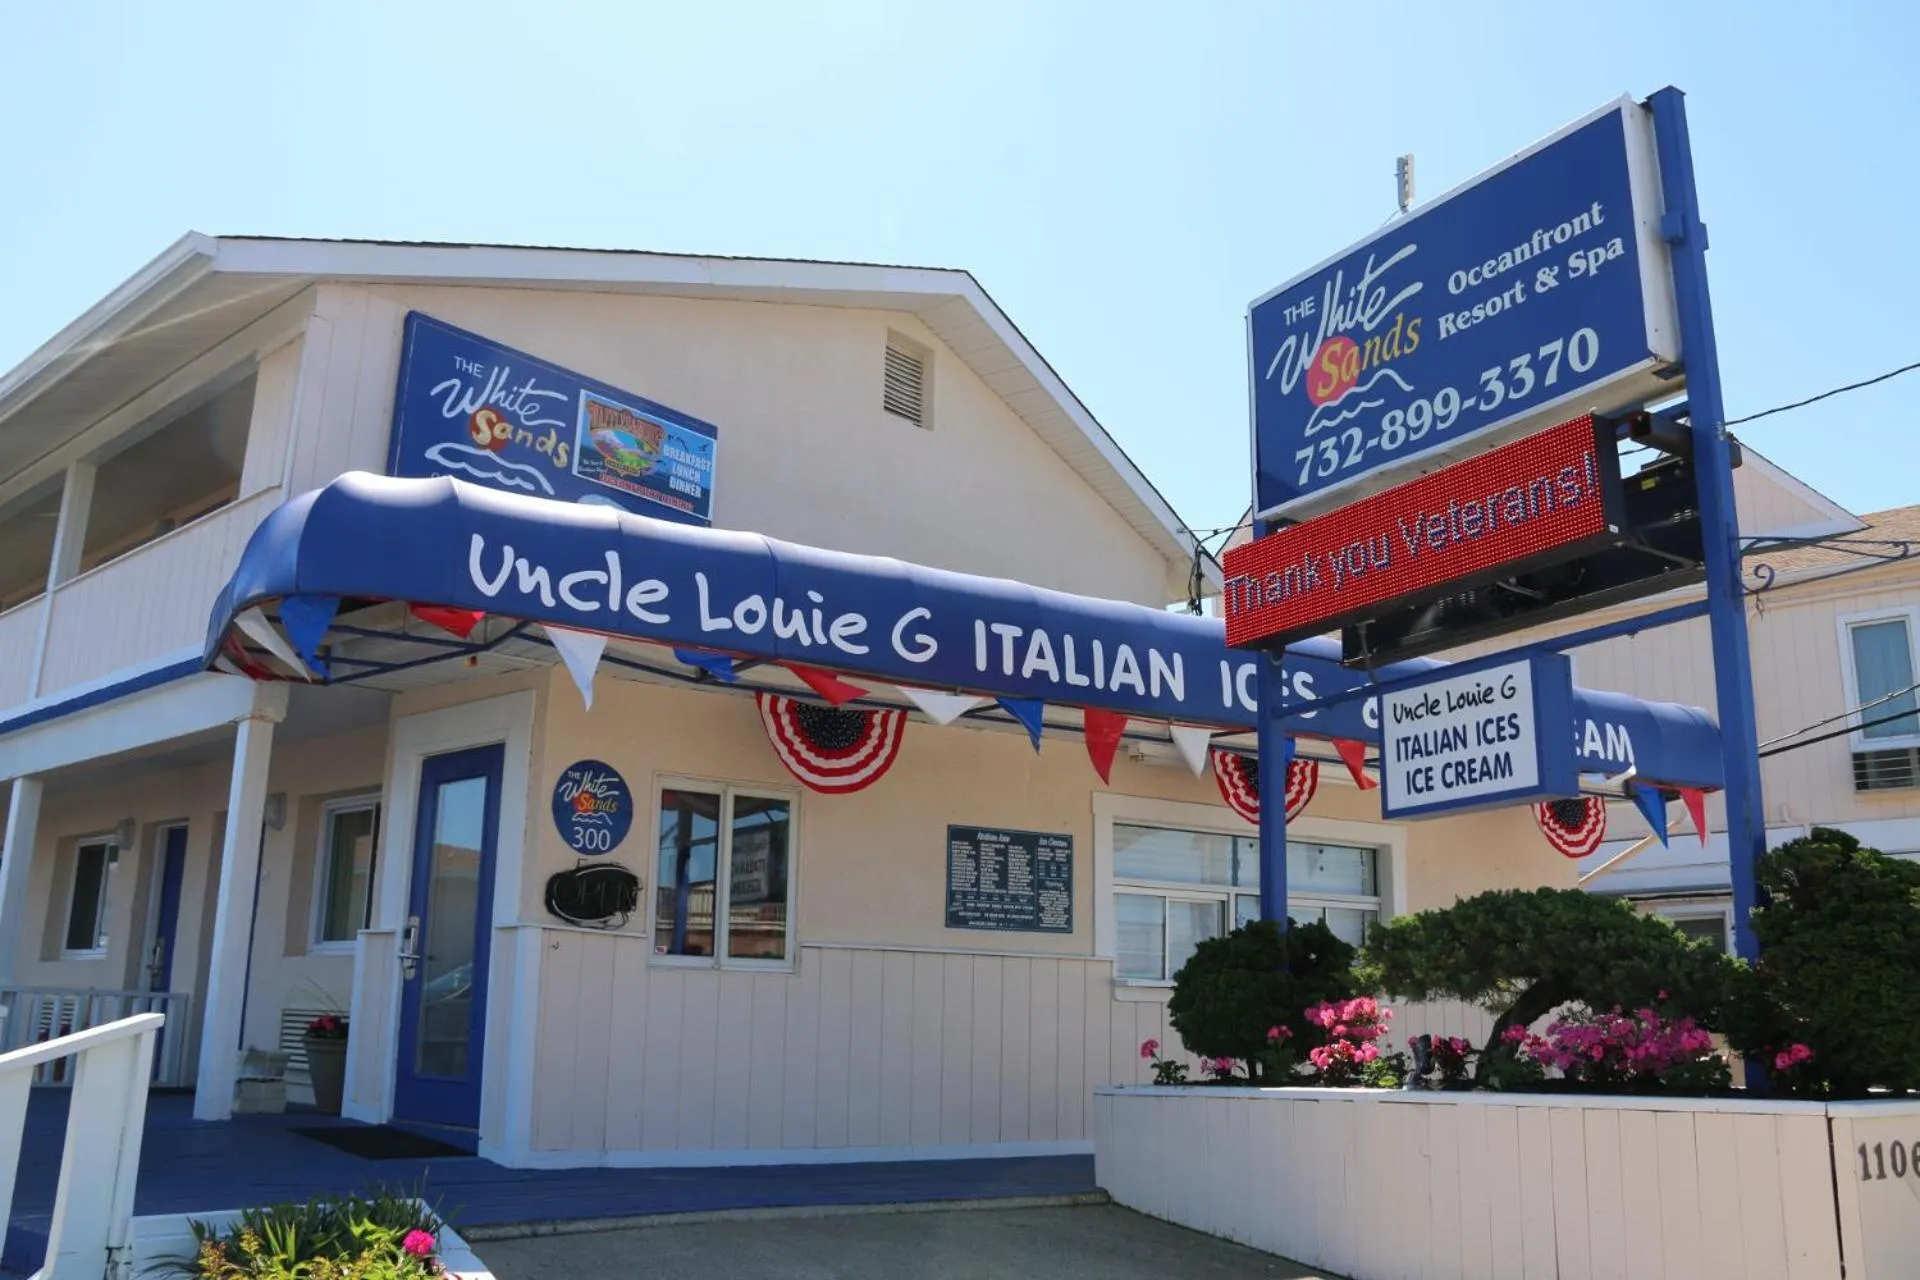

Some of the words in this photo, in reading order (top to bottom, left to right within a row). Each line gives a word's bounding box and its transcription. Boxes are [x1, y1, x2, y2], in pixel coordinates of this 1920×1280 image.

[1448, 200, 1605, 295] Oceanfront
[1266, 243, 1424, 395] White
[1283, 295, 1316, 326] THE
[1438, 280, 1528, 341] Resort
[1534, 263, 1561, 294] &
[1567, 236, 1625, 281] Spa
[453, 355, 485, 378] THE
[1316, 313, 1423, 398] Sands
[430, 366, 569, 427] White
[1294, 327, 1599, 486] 732-899-3370
[471, 408, 569, 469] Sands
[1224, 553, 1325, 617] Thank
[1328, 533, 1392, 592] you
[1397, 451, 1598, 559] Veterans!
[468, 533, 671, 625] Uncle
[694, 571, 870, 655] Louie
[891, 606, 938, 663] G
[974, 618, 1186, 702] ITALIAN
[1392, 698, 1442, 724] Uncle
[1446, 683, 1495, 714] Louie
[1500, 674, 1517, 700] G
[1396, 724, 1468, 763] ITALIAN
[1476, 712, 1521, 747] ICES
[559, 769, 620, 802] White
[577, 792, 619, 813] Sands
[1406, 766, 1434, 795] ICE
[1441, 752, 1514, 789] CREAM
[572, 826, 611, 851] 300
